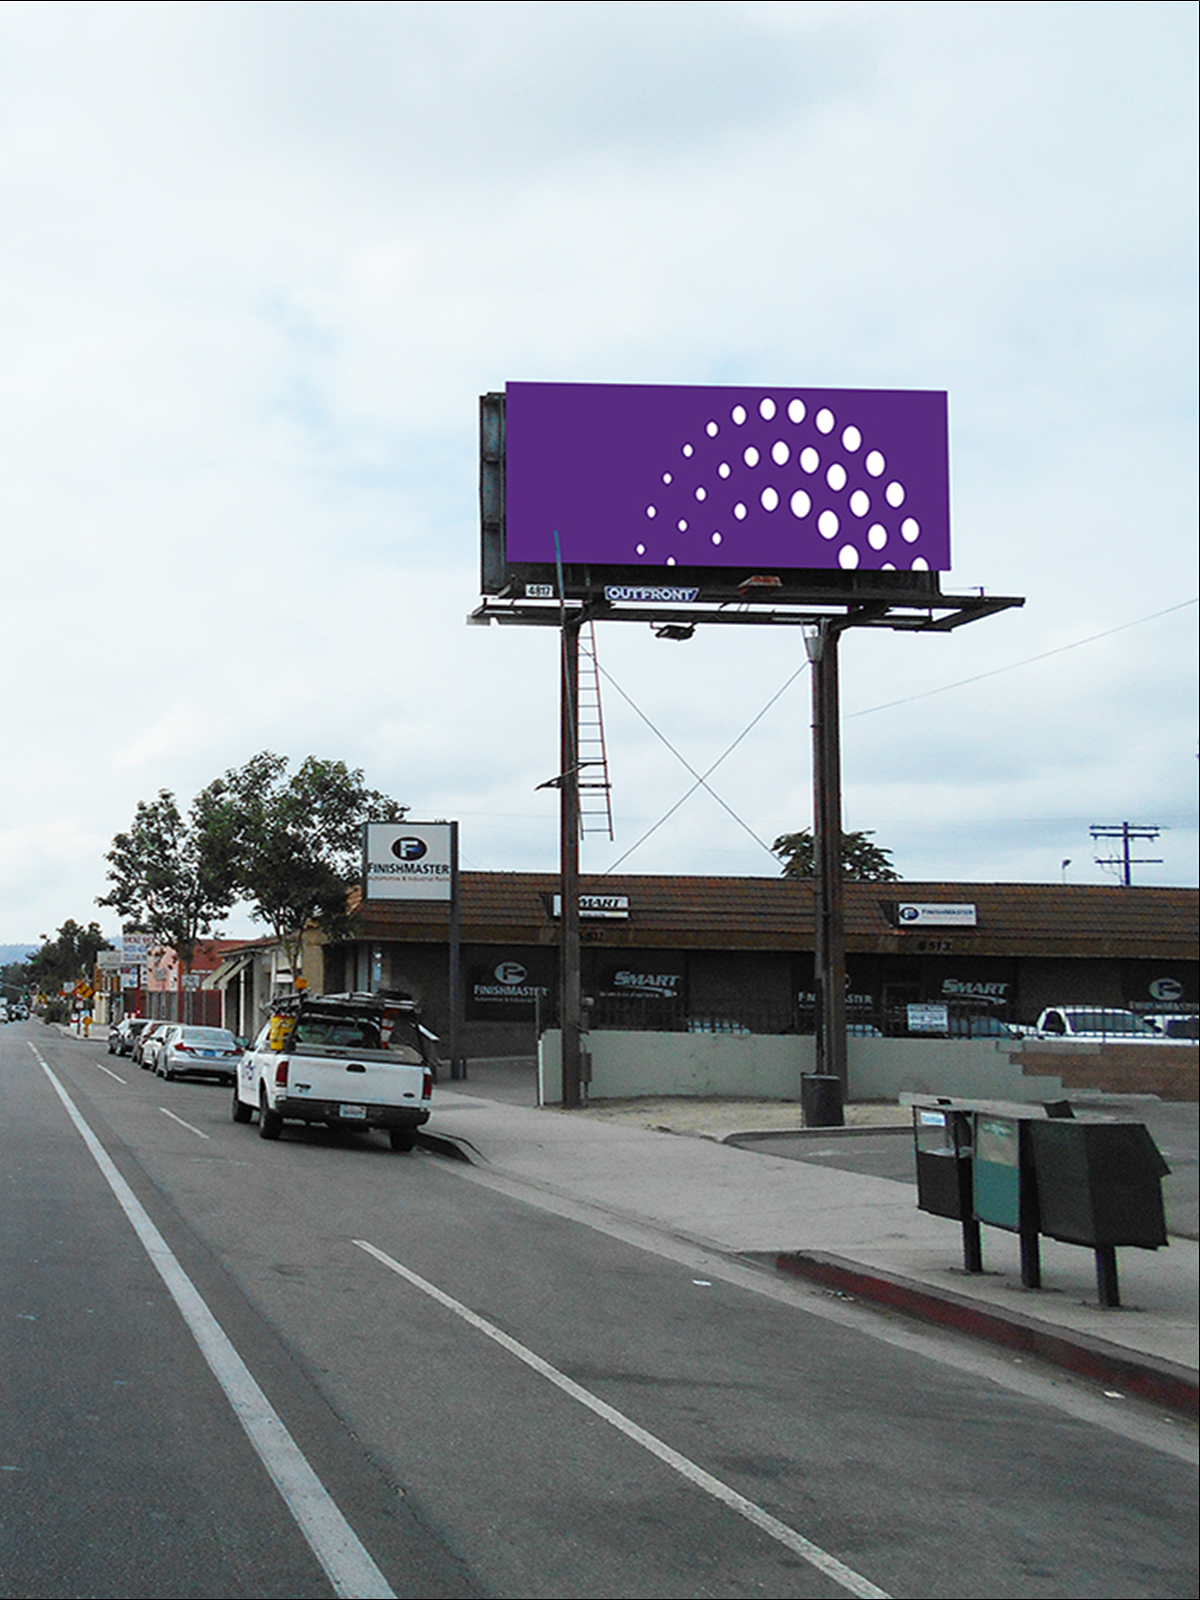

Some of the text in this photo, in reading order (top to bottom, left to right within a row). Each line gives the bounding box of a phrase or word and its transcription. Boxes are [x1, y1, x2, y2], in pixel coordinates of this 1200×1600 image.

[609, 587, 692, 600] OUTFRONT
[367, 862, 450, 875] FINISHMASTER
[580, 897, 620, 907] MART
[614, 971, 680, 987] SMART
[941, 979, 1010, 994] SMART
